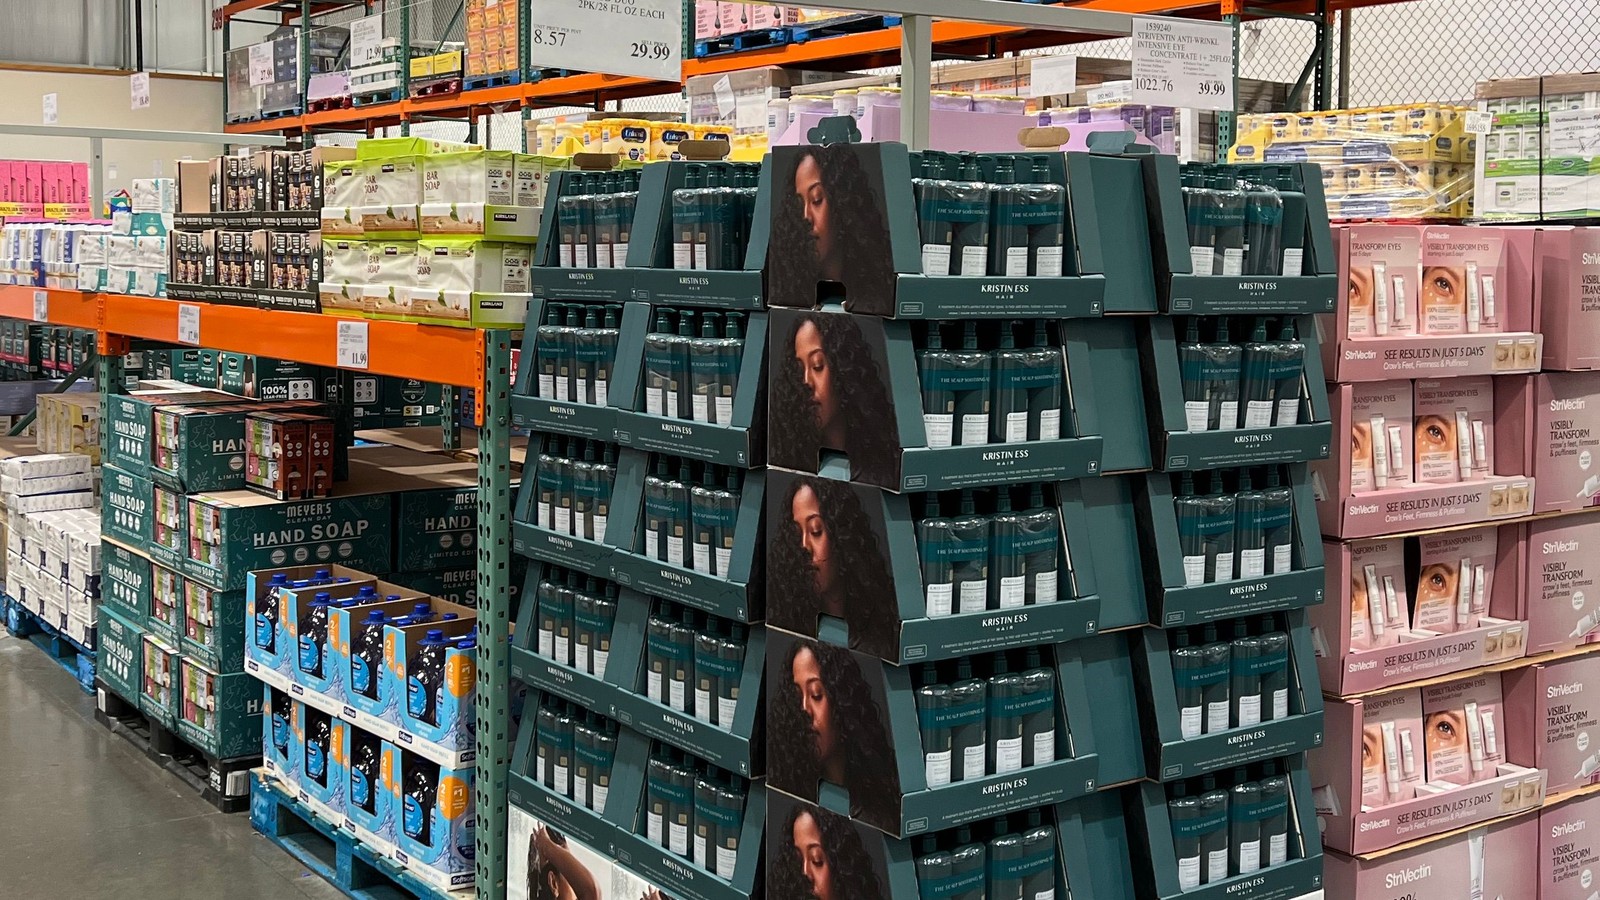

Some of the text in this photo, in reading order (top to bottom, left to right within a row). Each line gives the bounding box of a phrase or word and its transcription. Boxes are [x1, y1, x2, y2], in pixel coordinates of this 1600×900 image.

[578, 1, 665, 19] 2PK/28 FL OZ EACH
[534, 29, 566, 47] 8.57
[366, 44, 382, 60] 12.99
[631, 43, 670, 60] 29.99
[1137, 41, 1172, 50] INTENSIVE
[1150, 50, 1198, 60] CONCENTRATE
[1135, 78, 1174, 92] 1022.76
[1198, 82, 1226, 96] 39.99
[314, 175, 320, 188] 6
[426, 170, 438, 180] BAR
[257, 178, 263, 190] 6
[326, 178, 336, 186] BAR
[425, 180, 440, 190] SOAP
[1352, 243, 1386, 251] TRANSFORM
[1445, 244, 1476, 252] TRANSFORM
[312, 258, 318, 270] 6
[369, 255, 380, 264] BAR
[680, 277, 698, 285] KRISTIN
[981, 284, 1029, 293] KRISTIN ESS
[352, 352, 367, 365] 11.99
[1345, 350, 1377, 360] StriVectin
[1384, 350, 1397, 360] SEE
[1399, 348, 1430, 359] RESULTS
[1432, 348, 1440, 358] IN
[1440, 348, 1458, 358] JUST
[1460, 347, 1464, 356] 5
[1384, 362, 1401, 370] Crow's
[1402, 361, 1415, 370] Feet,
[1416, 360, 1439, 368] Firmness
[1440, 360, 1444, 368] &
[262, 386, 287, 395] 100%
[1437, 390, 1466, 398] TRANSFORM
[1550, 399, 1585, 411] StriVectin
[114, 420, 146, 438] HAND SOAP
[1550, 420, 1574, 430] VISIBLY
[284, 433, 290, 441] 4
[1234, 435, 1260, 444] KRISTIN
[1550, 429, 1590, 440] TRANSFORM
[213, 439, 245, 453] HAN
[982, 450, 1029, 460] KRISTIN ESS
[110, 494, 145, 512] HAND SOAP
[1350, 505, 1379, 516] StriVectin
[1386, 503, 1399, 512] SEE
[1400, 500, 1429, 510] RESULTS
[1430, 498, 1439, 508] IN
[1440, 496, 1457, 507] JUST
[1458, 495, 1462, 504] 5
[287, 503, 332, 518] MEYER'S
[425, 515, 471, 530] HAND
[253, 520, 369, 546] HAND SOAP
[1542, 540, 1579, 554] StriVectin
[1542, 562, 1567, 572] VISIBLY
[108, 564, 142, 588] HAND SOAP
[660, 570, 692, 585] KRISTIN ESS
[1542, 569, 1583, 583] TRANSFORM
[1230, 583, 1268, 595] KRISTIN ESS
[982, 614, 1028, 627] KRISTIN ESS
[103, 634, 133, 662] HAND SOAP
[1547, 682, 1583, 698] StriVectin
[1547, 704, 1571, 716] VISIBLY
[1547, 710, 1588, 727] TRANSFORM
[1227, 730, 1266, 745] KRISTIN ESS
[982, 778, 1028, 795] KRISTIN ESS
[1360, 818, 1390, 832] StriVectin
[1552, 820, 1586, 838] StriVectin
[662, 858, 694, 880] KRISTIN ESS
[1386, 864, 1431, 888] StriVectin
[1226, 877, 1265, 894] KRISTIN ESS
